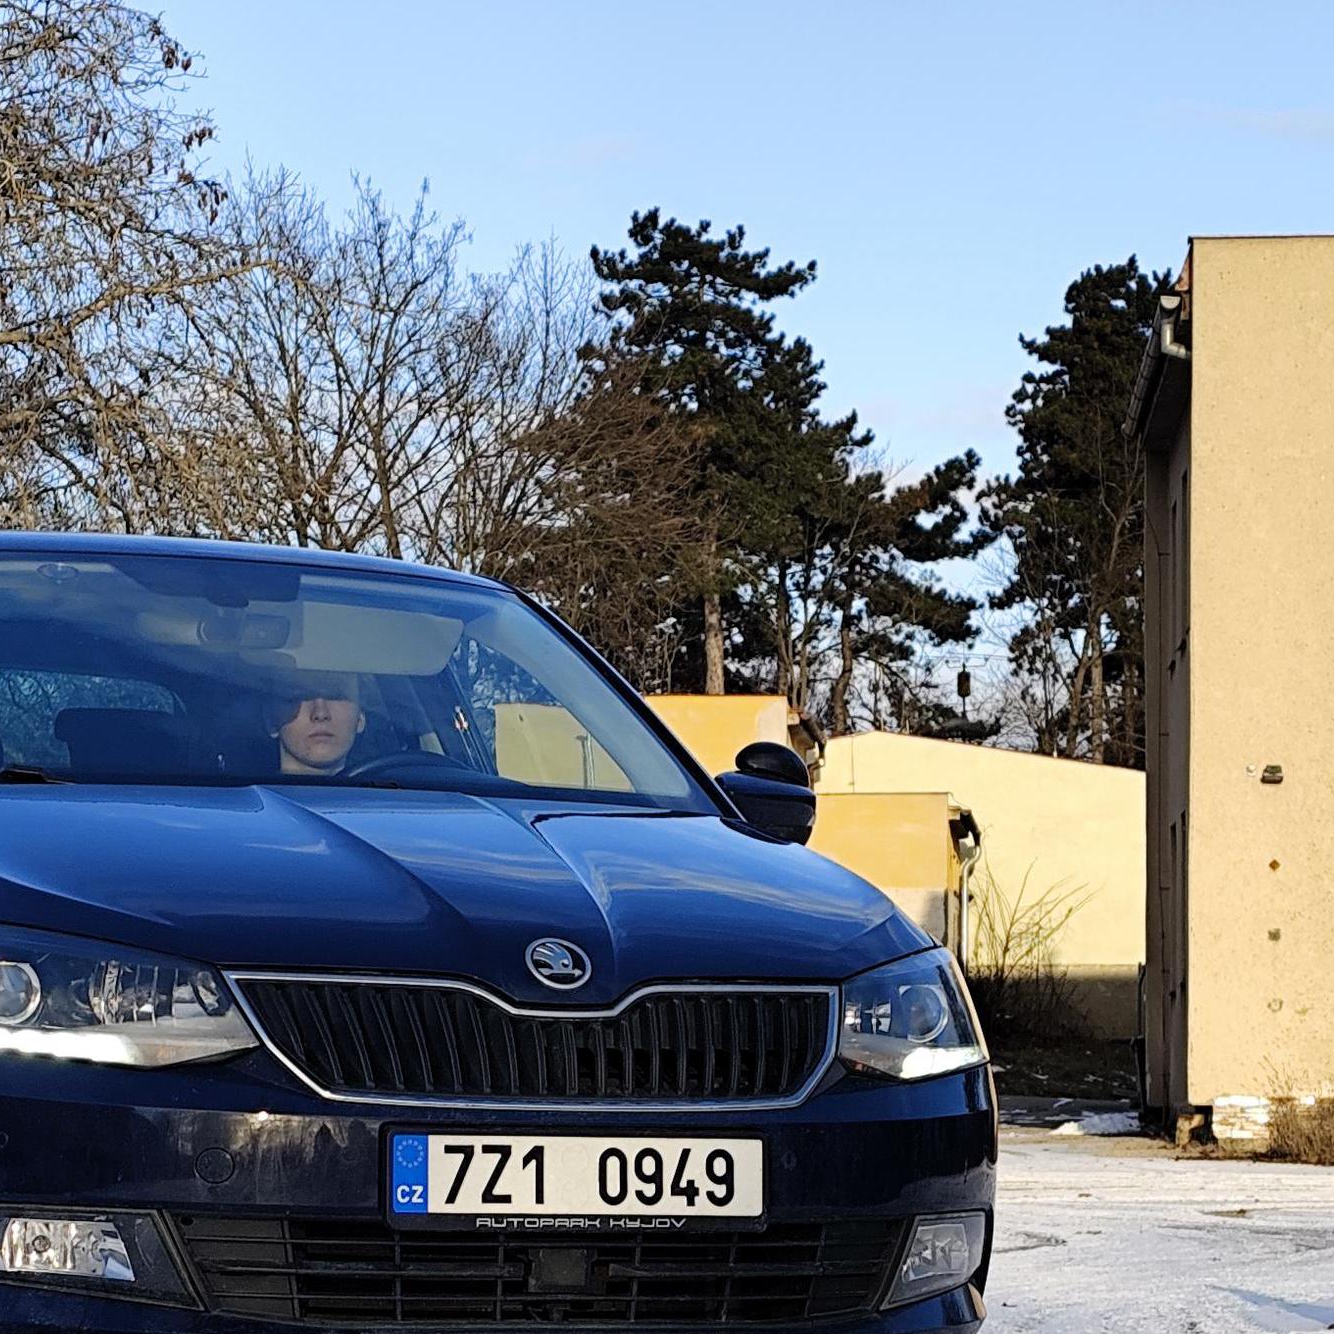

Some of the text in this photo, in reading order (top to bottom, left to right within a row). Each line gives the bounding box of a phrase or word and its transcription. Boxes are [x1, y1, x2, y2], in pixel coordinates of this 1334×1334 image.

[443, 1144, 736, 1207] 7Z1 0949
[396, 1185, 424, 1204] CZ
[475, 1217, 687, 1229] AUTOPARK KYJOV
